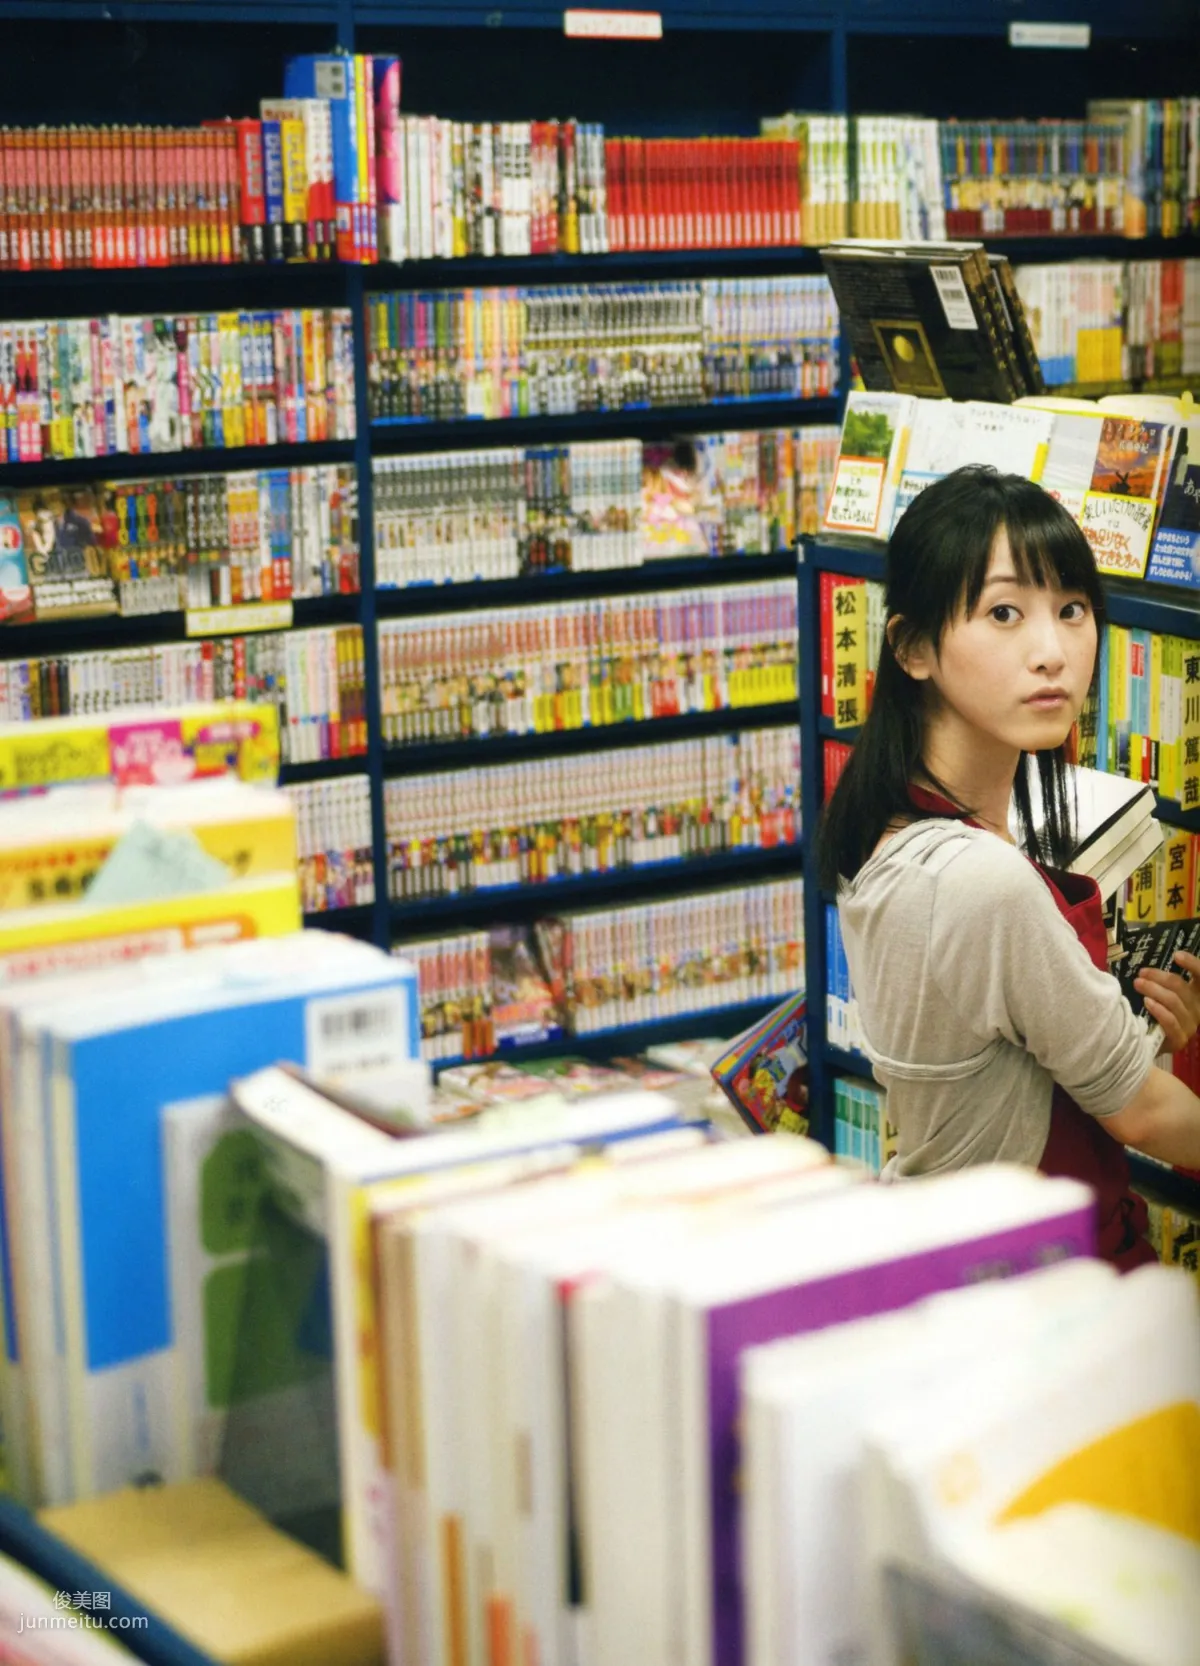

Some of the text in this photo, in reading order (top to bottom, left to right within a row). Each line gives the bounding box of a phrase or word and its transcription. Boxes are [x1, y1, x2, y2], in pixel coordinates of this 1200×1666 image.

[835, 591, 858, 723] 松本清張
[1184, 655, 1200, 804] 東川篤哉
[1135, 862, 1154, 919] 浦し
[1166, 844, 1187, 910] 宮本
